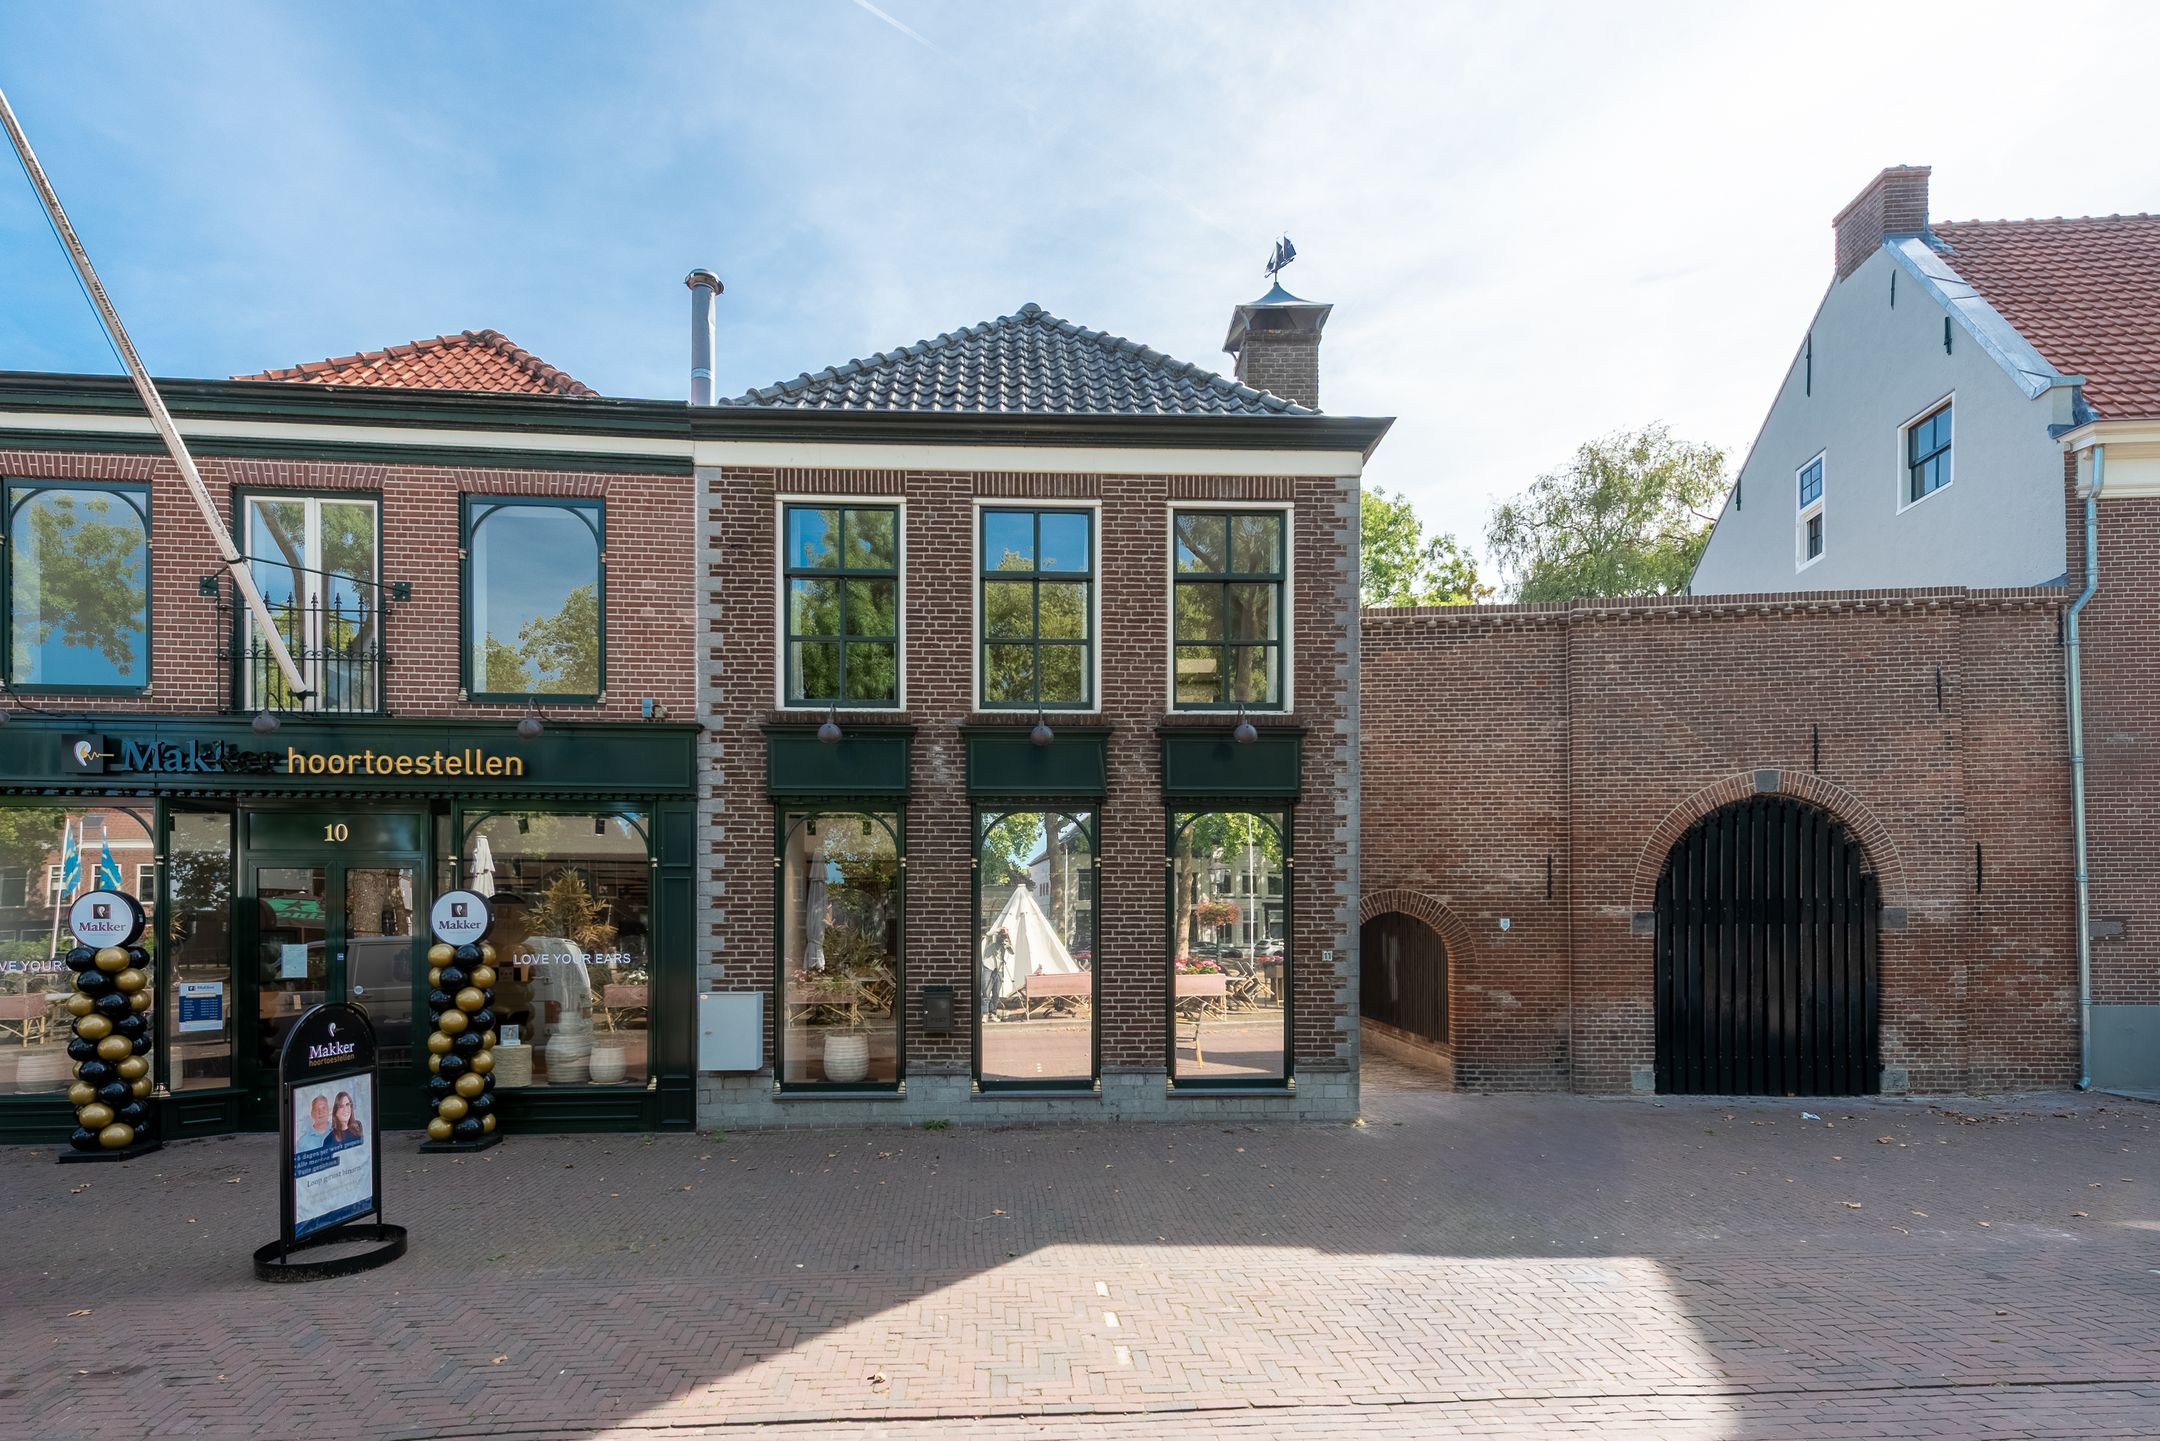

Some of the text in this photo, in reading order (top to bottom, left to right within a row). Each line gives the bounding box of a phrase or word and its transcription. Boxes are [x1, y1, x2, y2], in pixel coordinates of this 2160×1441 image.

[121, 739, 523, 776] Makker hoortoestellen
[323, 823, 349, 842] 10
[78, 921, 127, 932] Makker
[438, 919, 482, 930] Makker
[512, 953, 631, 965] LOVE YOUR EARS
[21, 960, 62, 972] YOUR
[308, 1041, 355, 1060] Makker
[309, 1053, 355, 1067] hoortoestellen
[307, 1178, 323, 1188] Loop
